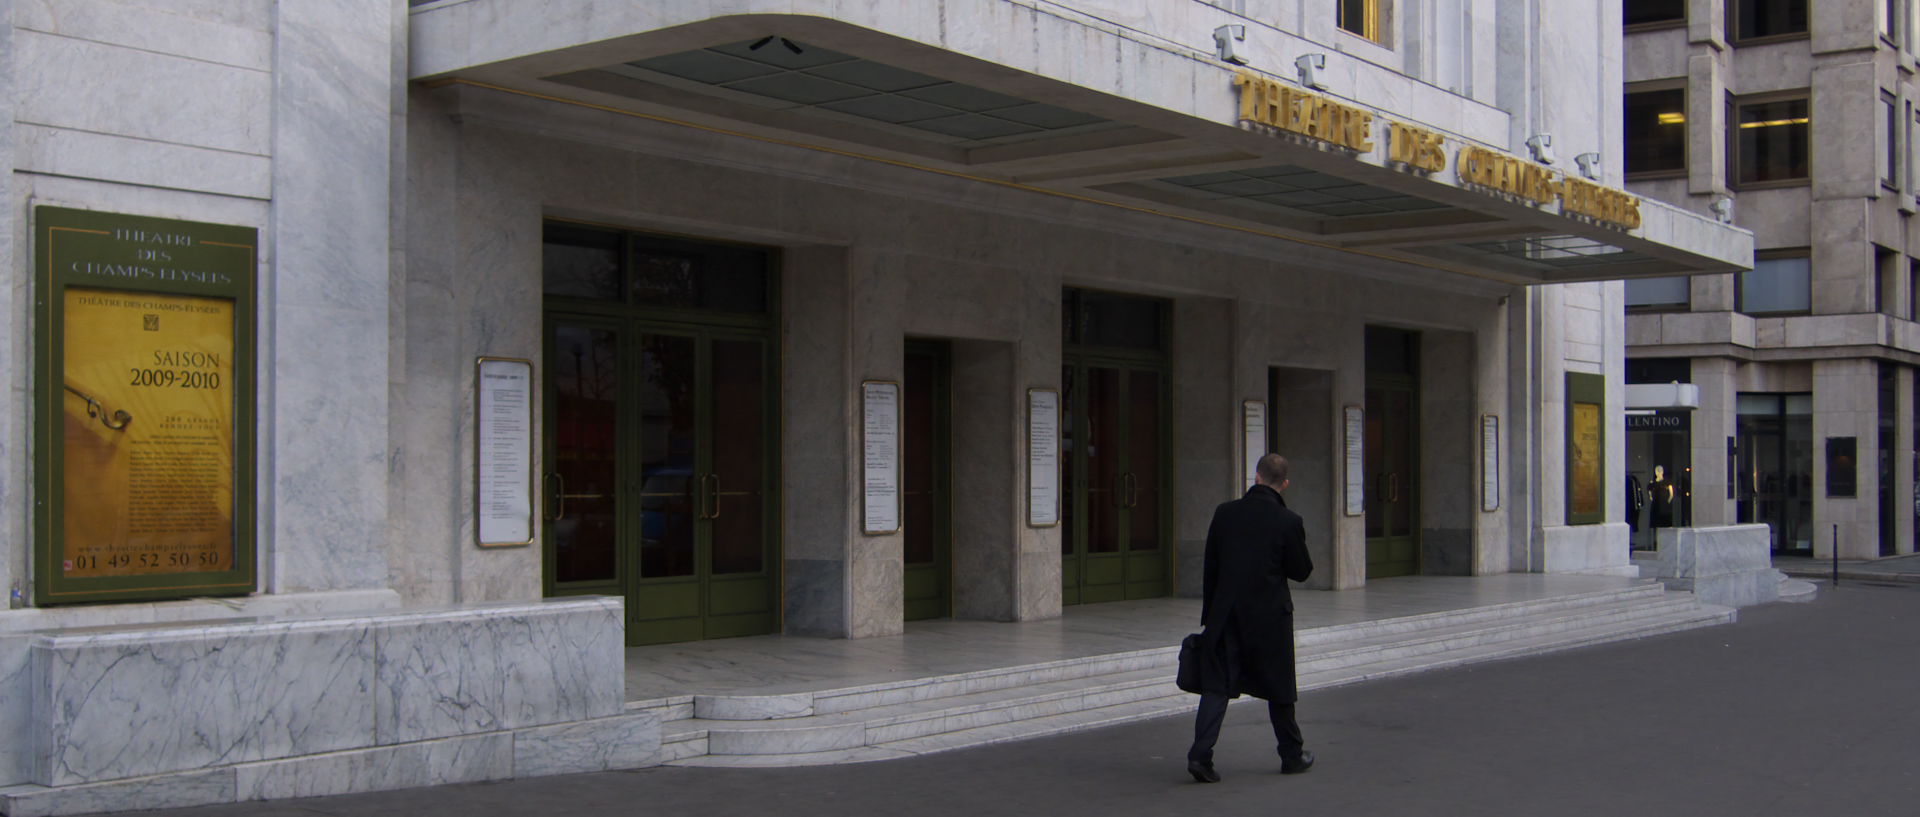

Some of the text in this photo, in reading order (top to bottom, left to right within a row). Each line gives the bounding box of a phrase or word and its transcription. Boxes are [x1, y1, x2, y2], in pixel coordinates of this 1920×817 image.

[1232, 73, 1373, 153] THEATRE
[1389, 121, 1446, 173] DES
[114, 227, 193, 248] THEATRE
[136, 247, 172, 262] DES
[72, 260, 232, 284] CHAMPS ELYSEES
[154, 350, 220, 368] SAISON
[130, 368, 220, 390] 2009-2010
[1627, 416, 1680, 427] LENTINO
[76, 551, 220, 570] 01 49 52 50 50
